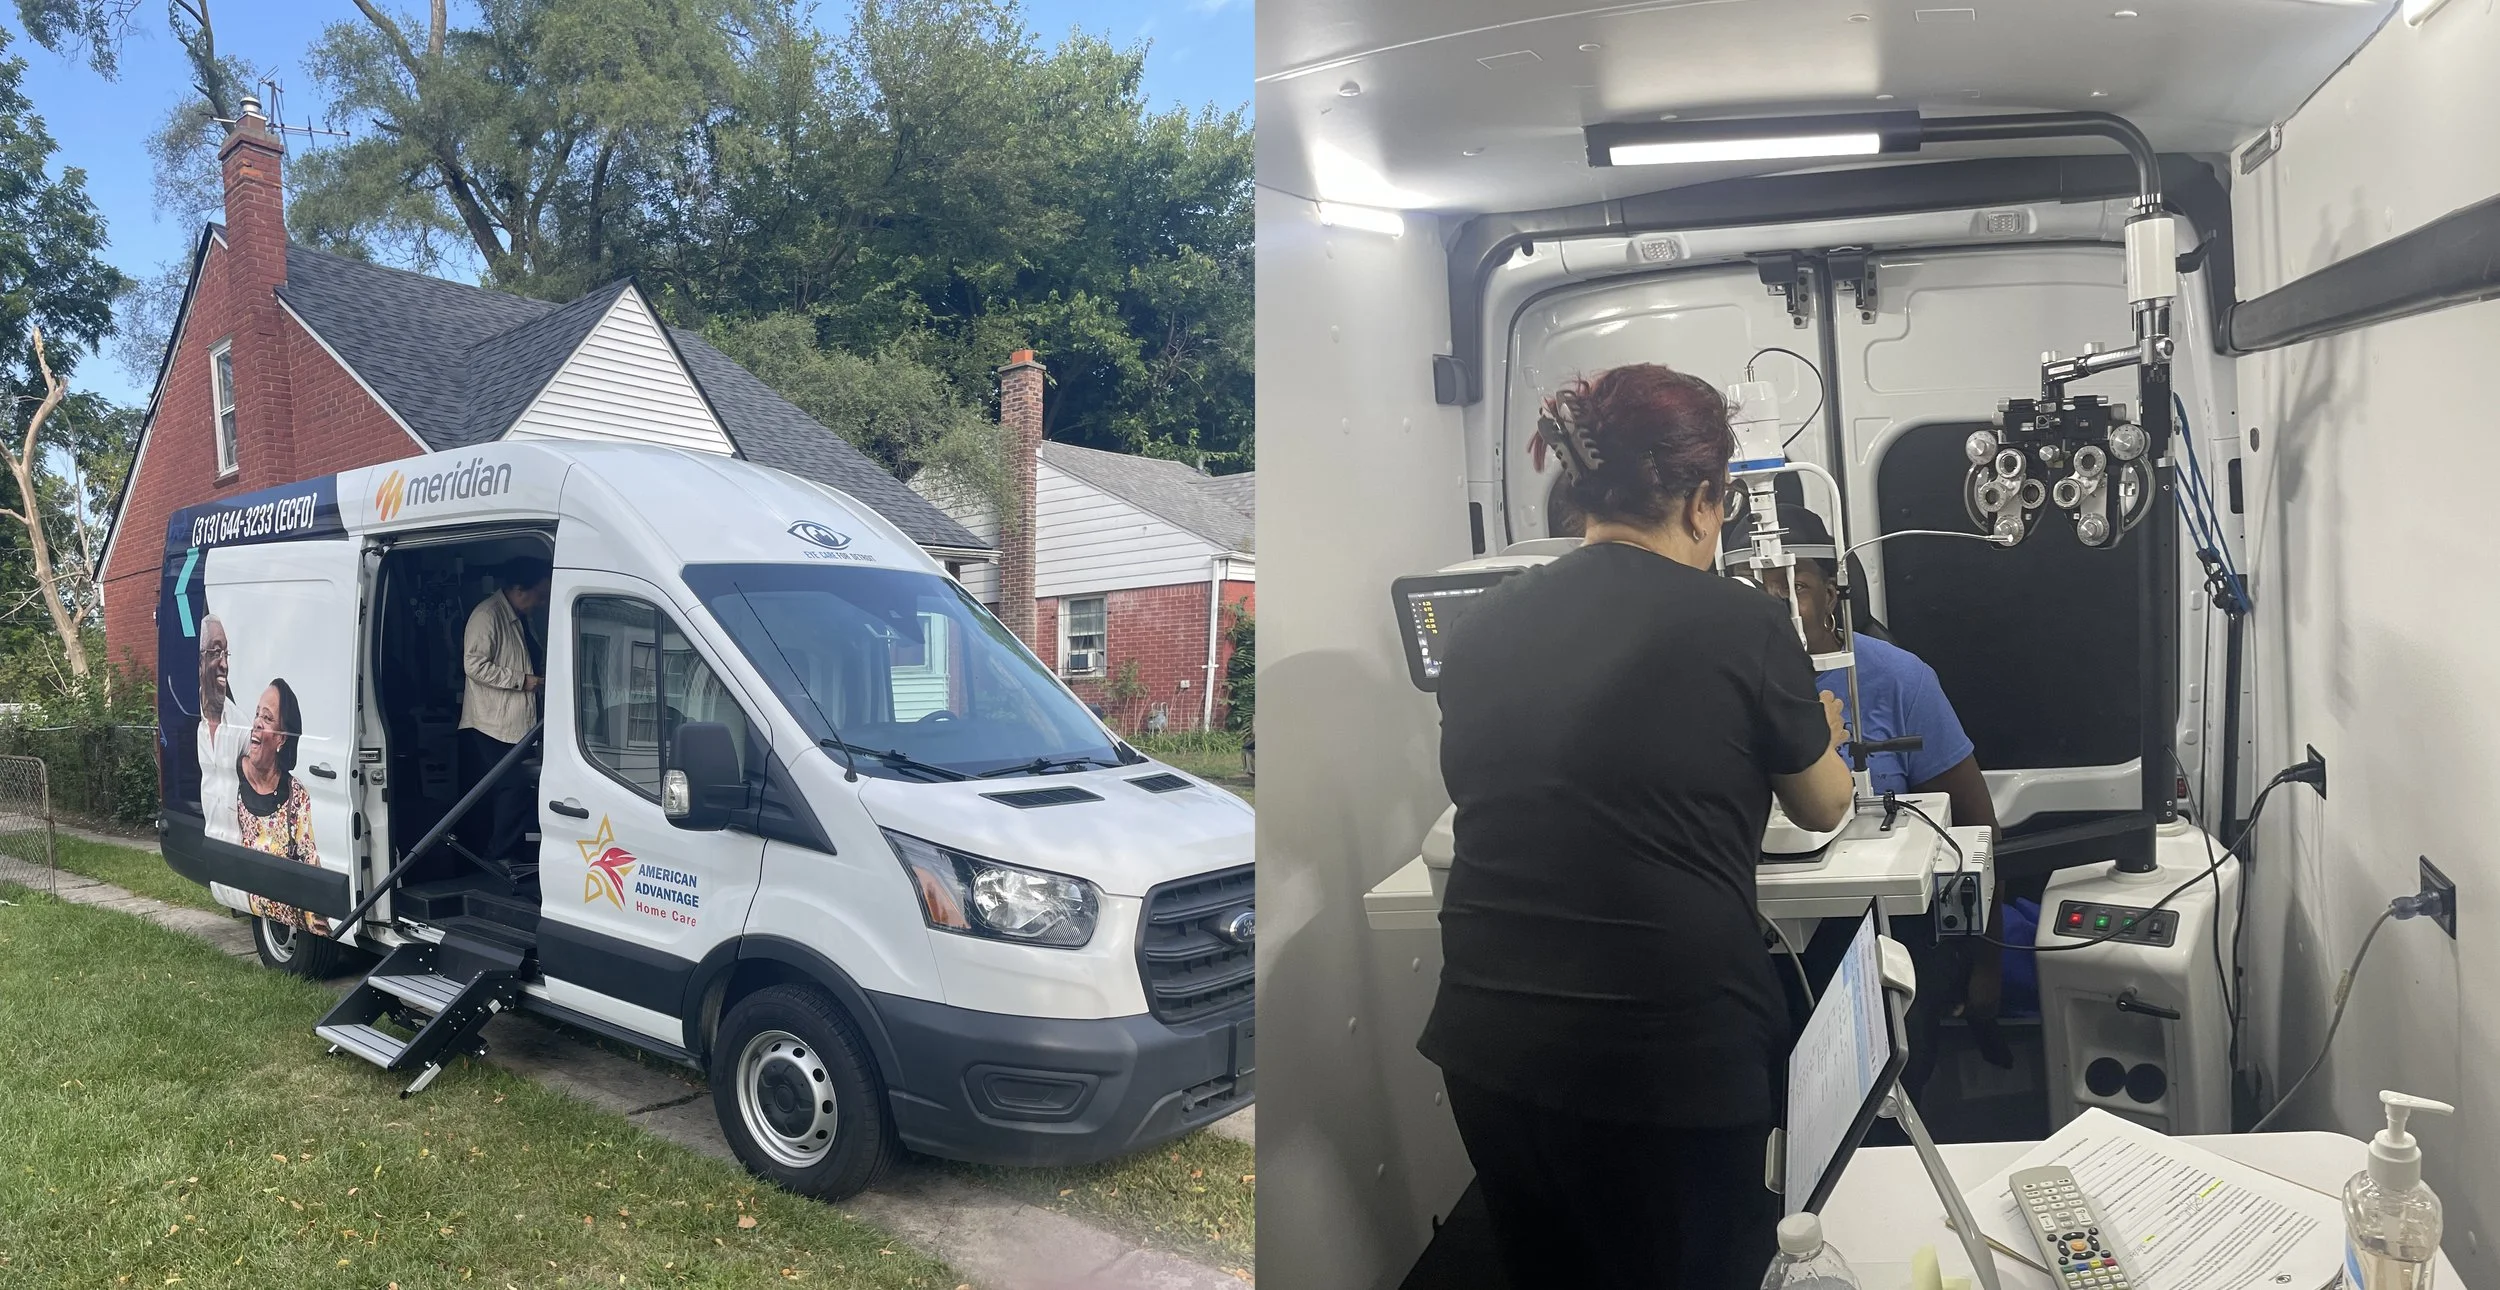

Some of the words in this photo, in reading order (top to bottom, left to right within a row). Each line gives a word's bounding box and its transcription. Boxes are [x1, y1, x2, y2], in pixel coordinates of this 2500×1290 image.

[406, 457, 512, 506] meridian
[191, 512, 221, 548] (313)
[219, 502, 275, 542] 644-3233
[274, 492, 318, 534] (ECFD)
[803, 551, 821, 559] EYE
[638, 863, 698, 888] AMERICAN
[635, 882, 700, 908] ADVANTAGE
[636, 901, 667, 918] Home
[672, 910, 697, 927] Care
